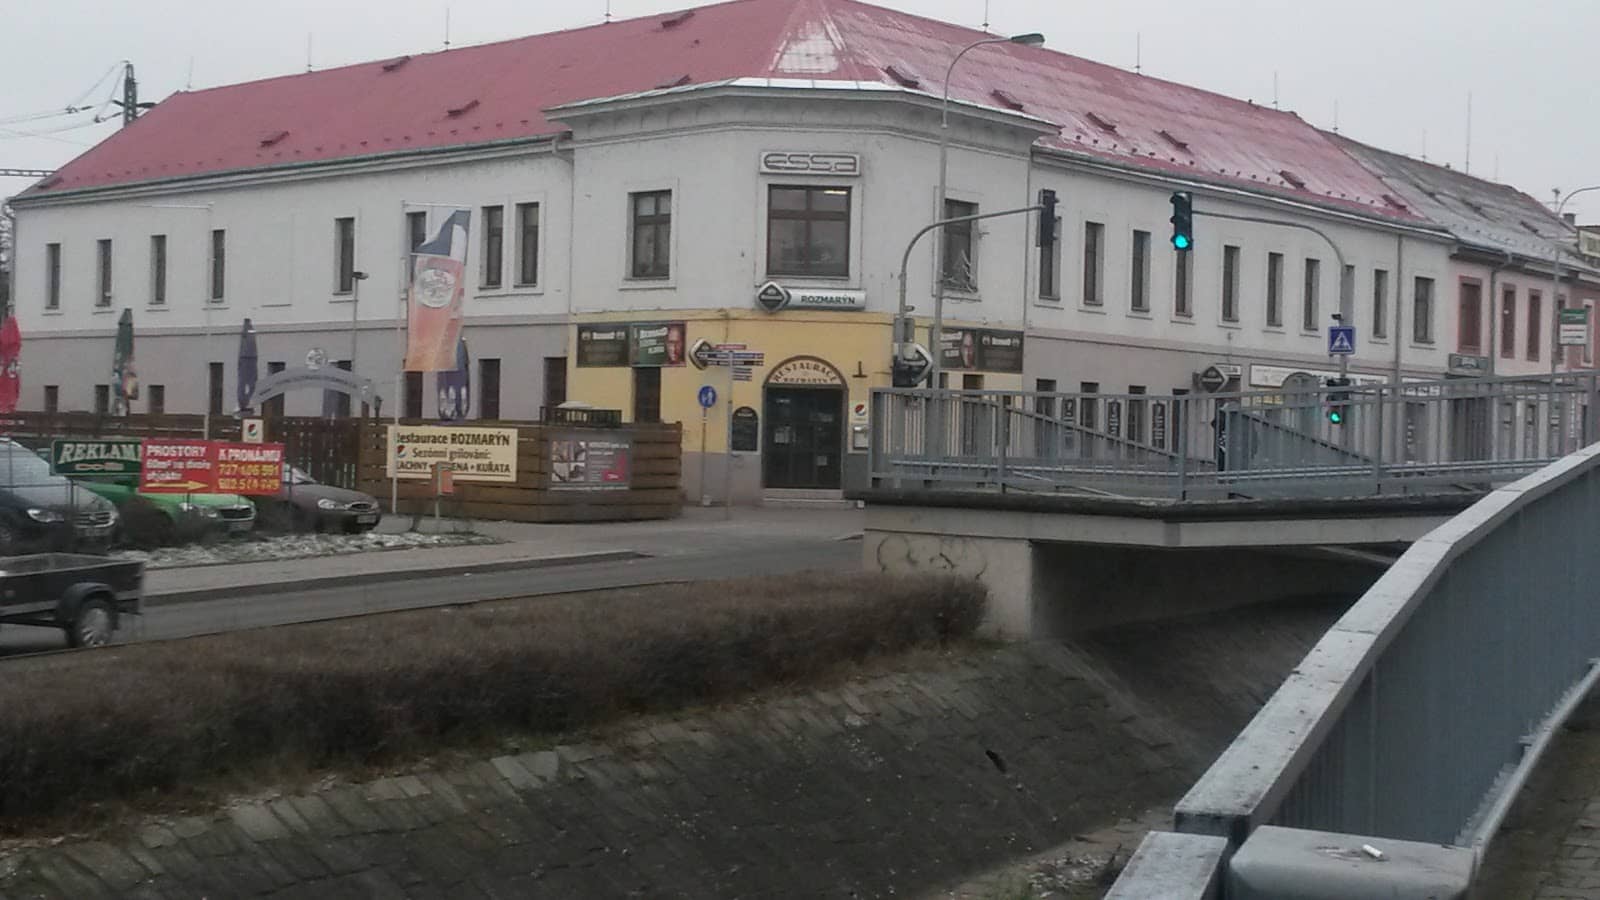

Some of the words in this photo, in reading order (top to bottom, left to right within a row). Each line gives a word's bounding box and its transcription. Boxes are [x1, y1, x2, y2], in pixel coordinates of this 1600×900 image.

[800, 294, 855, 305] ROZMARÝN
[450, 431, 511, 447] ROZMARÝN
[146, 444, 207, 457] PROSTORY
[228, 445, 281, 462] PRONÁJMU
[476, 460, 512, 473] KUŘATA
